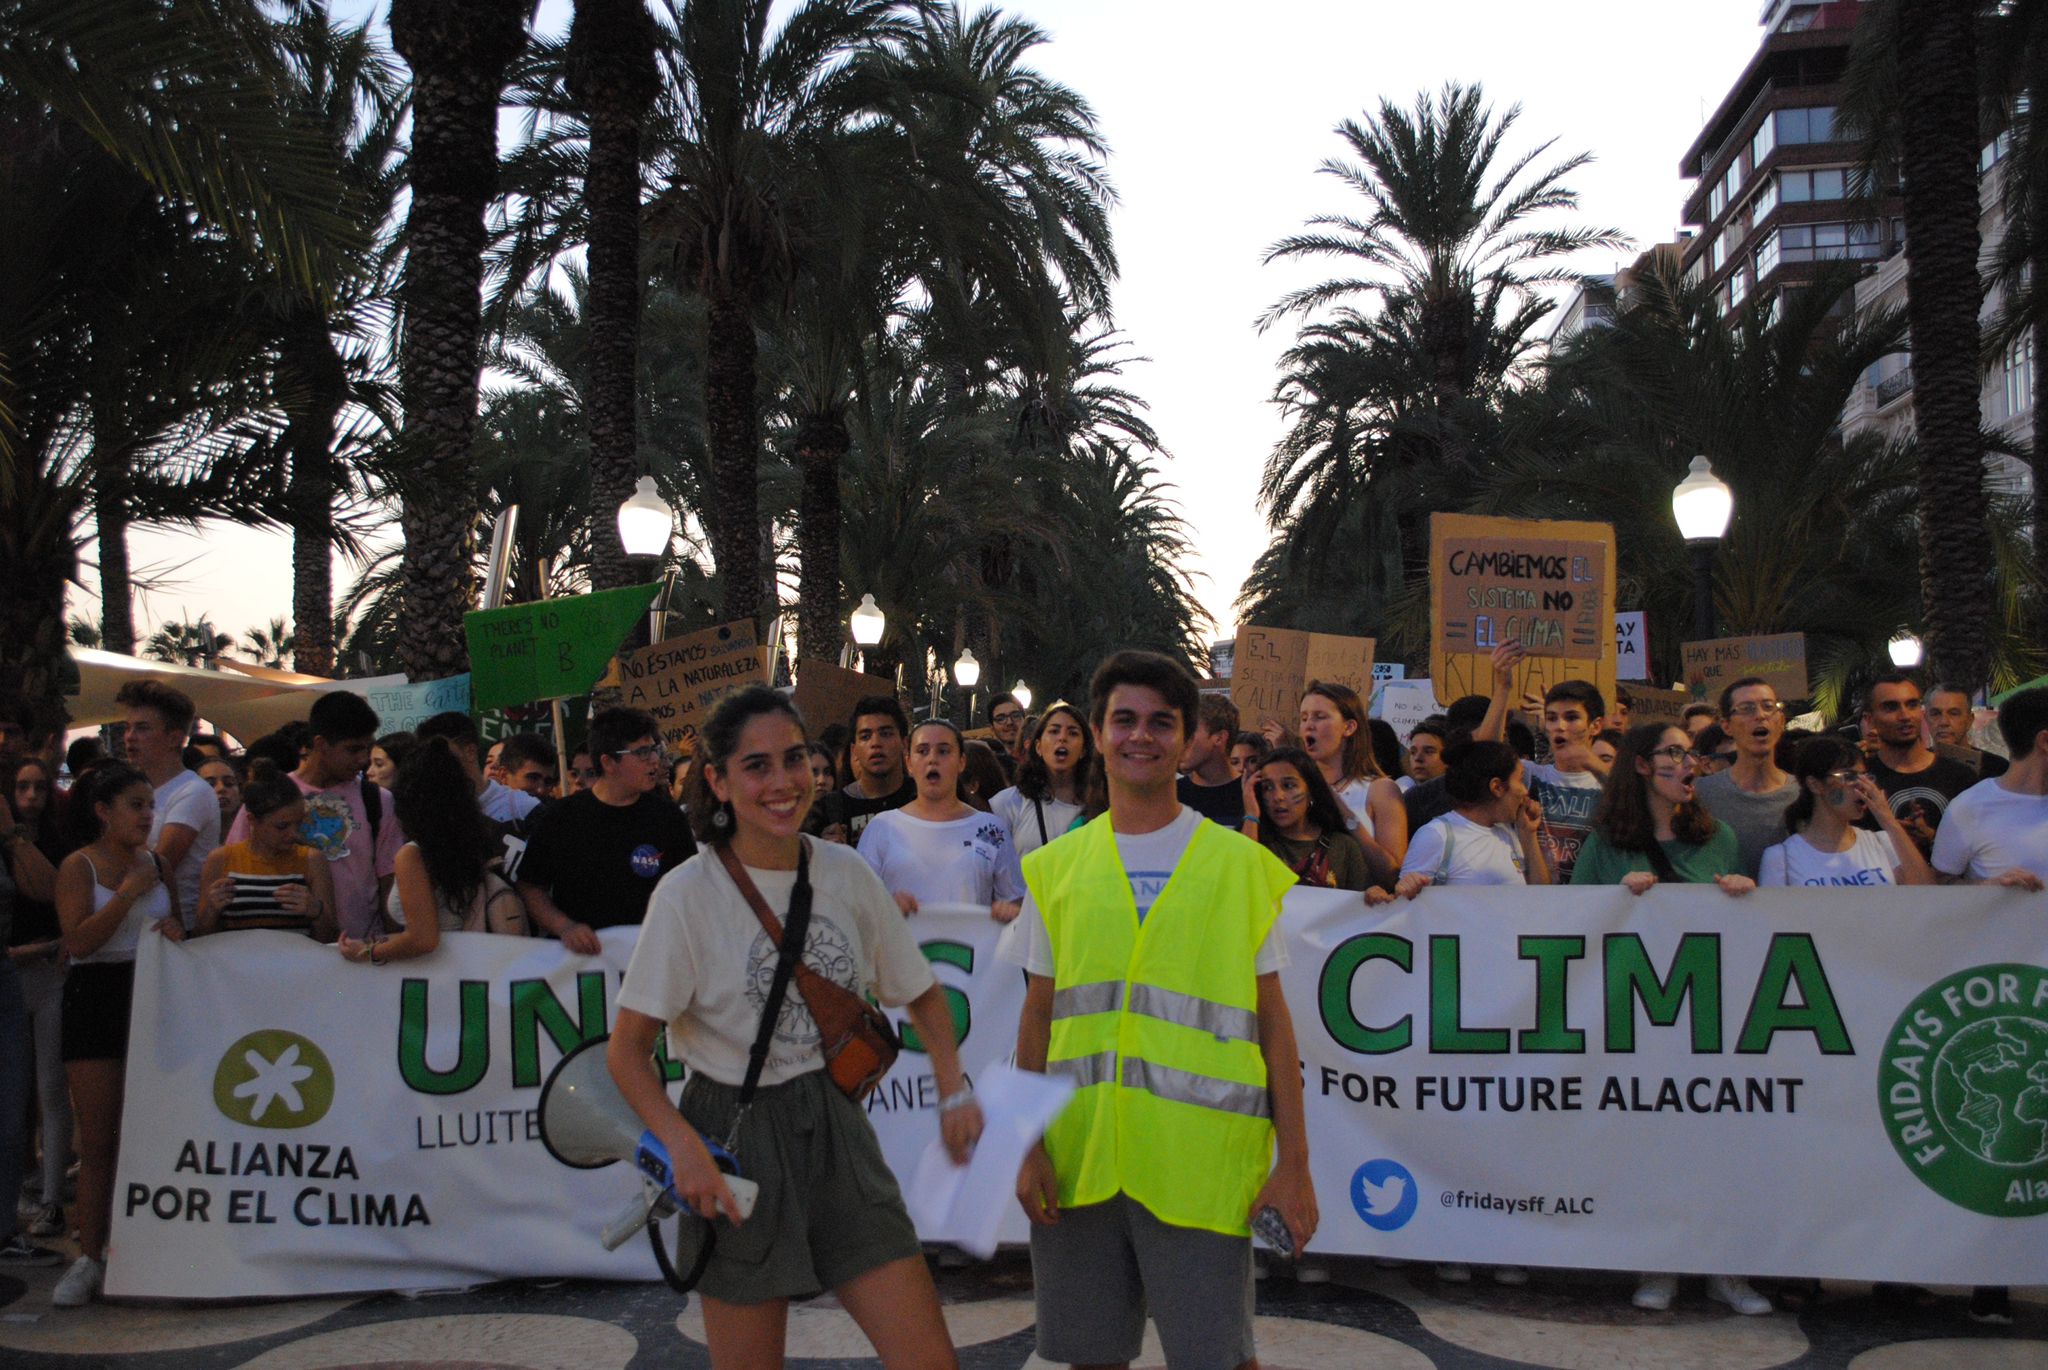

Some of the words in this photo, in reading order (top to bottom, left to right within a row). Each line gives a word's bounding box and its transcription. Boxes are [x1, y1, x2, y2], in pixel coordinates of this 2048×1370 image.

[1449, 549, 1567, 579] CAMBIEMOS
[1571, 556, 1593, 583] EL
[1467, 586, 1538, 610] SISTEMA
[1542, 590, 1574, 611] NO
[1474, 615, 1498, 648] EL
[1616, 622, 1636, 638] AY
[559, 641, 577, 673] B
[621, 660, 644, 681] NO
[648, 643, 707, 677] ESTAMOS
[1686, 645, 1709, 664] HAY
[1702, 664, 1723, 679] QUE
[631, 686, 647, 704] A
[657, 679, 680, 698] LA
[683, 657, 761, 689] NATURALEZA
[372, 690, 414, 714] THE
[1318, 932, 1857, 1057] CLIMA
[1889, 1008, 1946, 1167] FRIDAYS
[1940, 972, 2020, 1018] FOR
[1320, 1065, 1400, 1110] FOR
[1416, 1075, 1583, 1112] FUTURE
[1598, 1076, 1804, 1114] ALACANT
[416, 1110, 542, 1150] LLUITE
[175, 1139, 360, 1181] ALIANZA
[126, 1182, 211, 1223] POR
[227, 1189, 277, 1224] EL
[294, 1186, 432, 1228] CLIMA
[1440, 1190, 1595, 1216] @fridaysff_ALC
